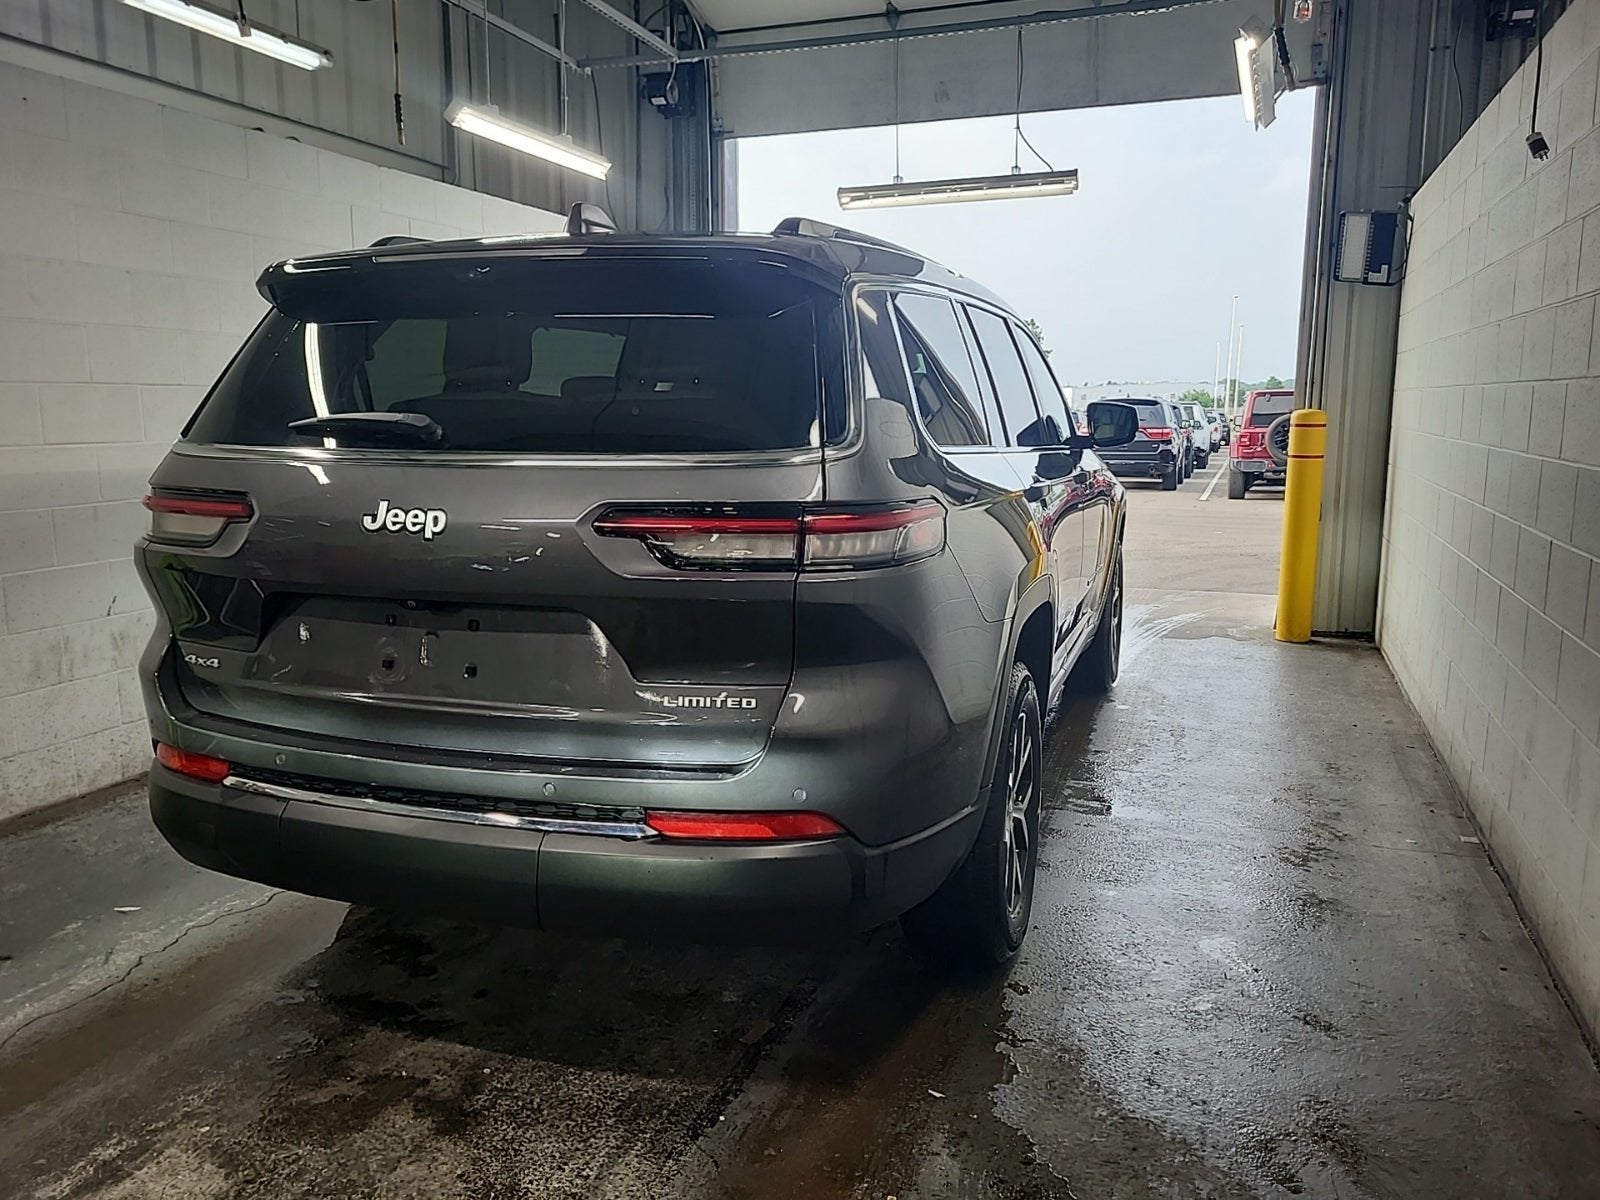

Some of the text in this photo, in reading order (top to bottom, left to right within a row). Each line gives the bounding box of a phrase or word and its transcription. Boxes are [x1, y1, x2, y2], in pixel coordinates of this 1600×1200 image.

[362, 499, 447, 541] Jeep
[184, 654, 220, 668] 4x4
[662, 692, 757, 709] LIMITED
